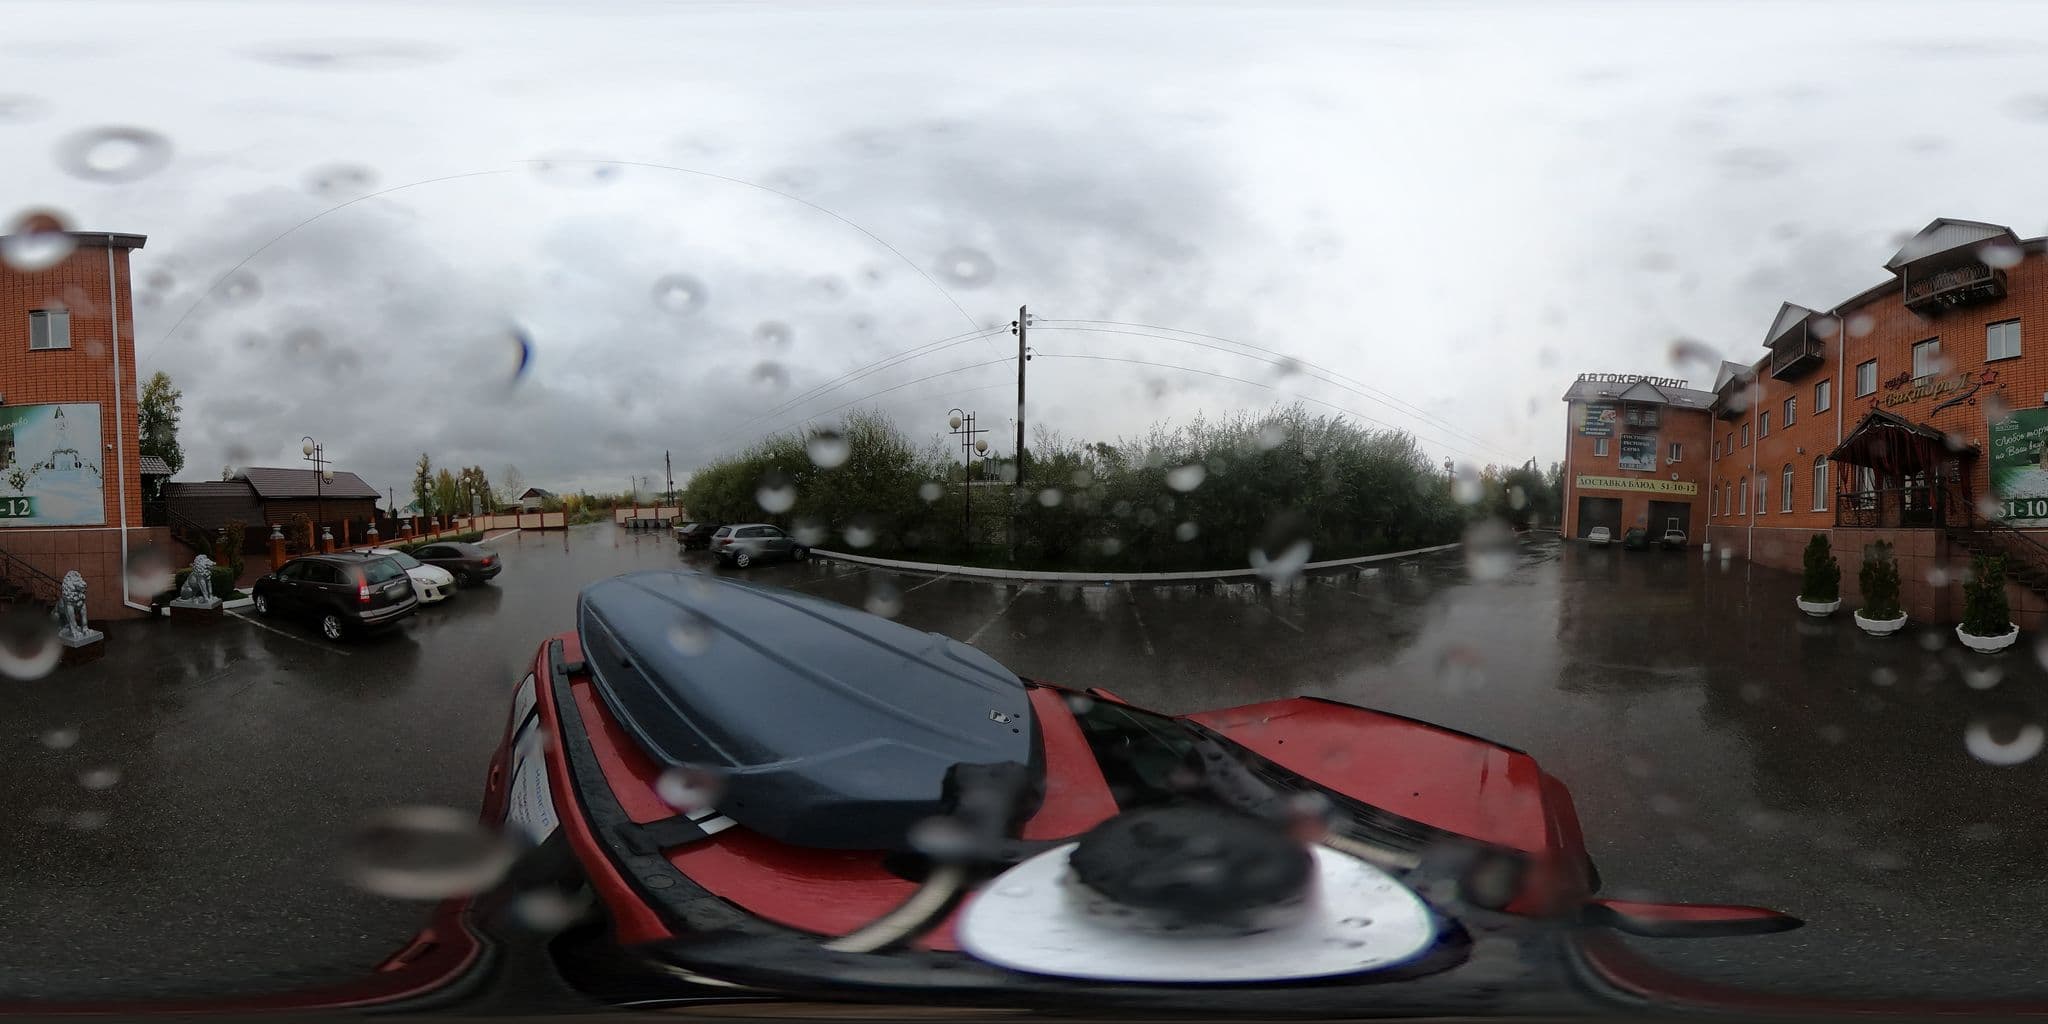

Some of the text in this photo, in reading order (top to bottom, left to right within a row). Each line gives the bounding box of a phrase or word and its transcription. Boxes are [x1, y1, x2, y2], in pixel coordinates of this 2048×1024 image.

[1577, 373, 1688, 389] АВТОКЕМПИНГ
[1579, 478, 1696, 492] ДОСТАВКА БЛЮД 51-10-12
